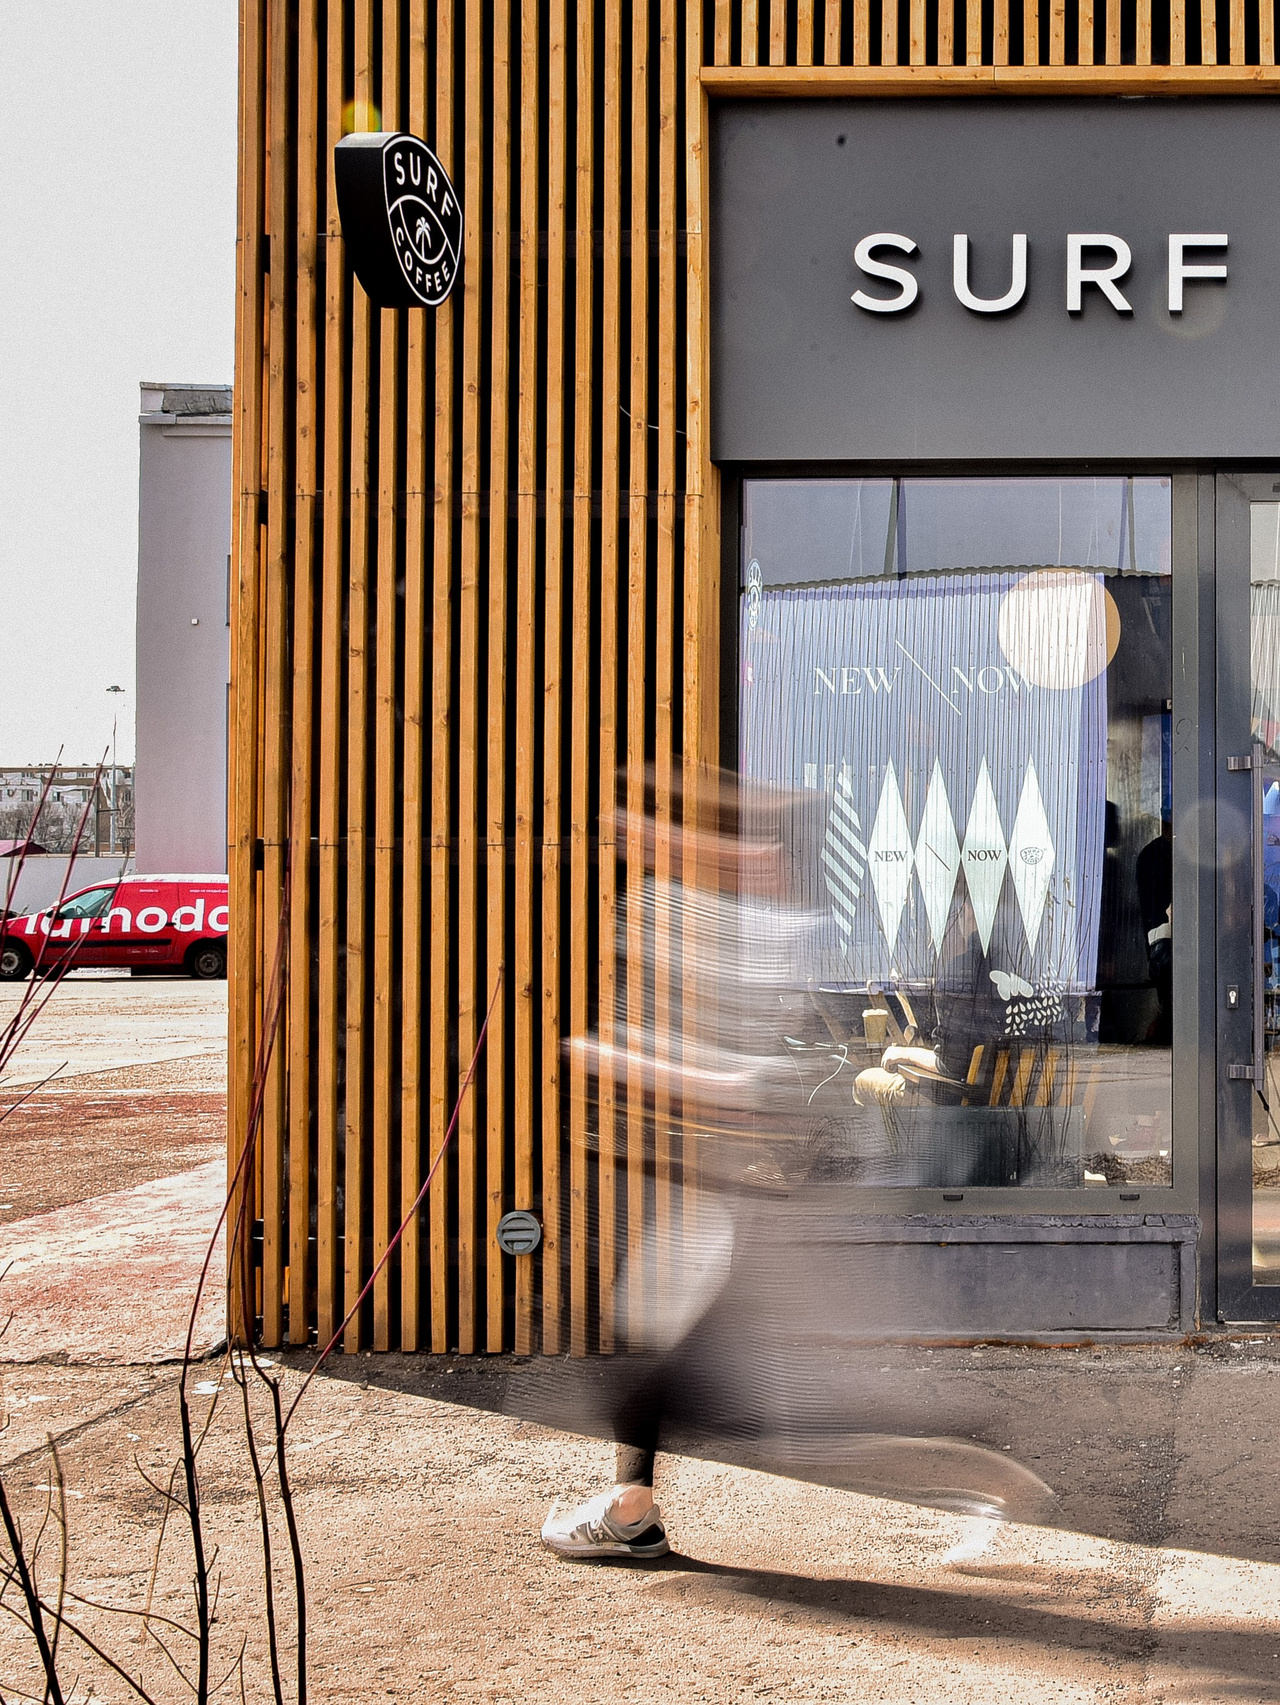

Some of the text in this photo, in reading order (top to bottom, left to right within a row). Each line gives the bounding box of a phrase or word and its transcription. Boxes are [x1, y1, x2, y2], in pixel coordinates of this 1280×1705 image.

[394, 152, 454, 216] SURF
[395, 226, 451, 293] COFFEE
[851, 232, 1229, 314] SURF
[814, 665, 1036, 694] NEW NOW
[874, 850, 1002, 862] NEW NOW
